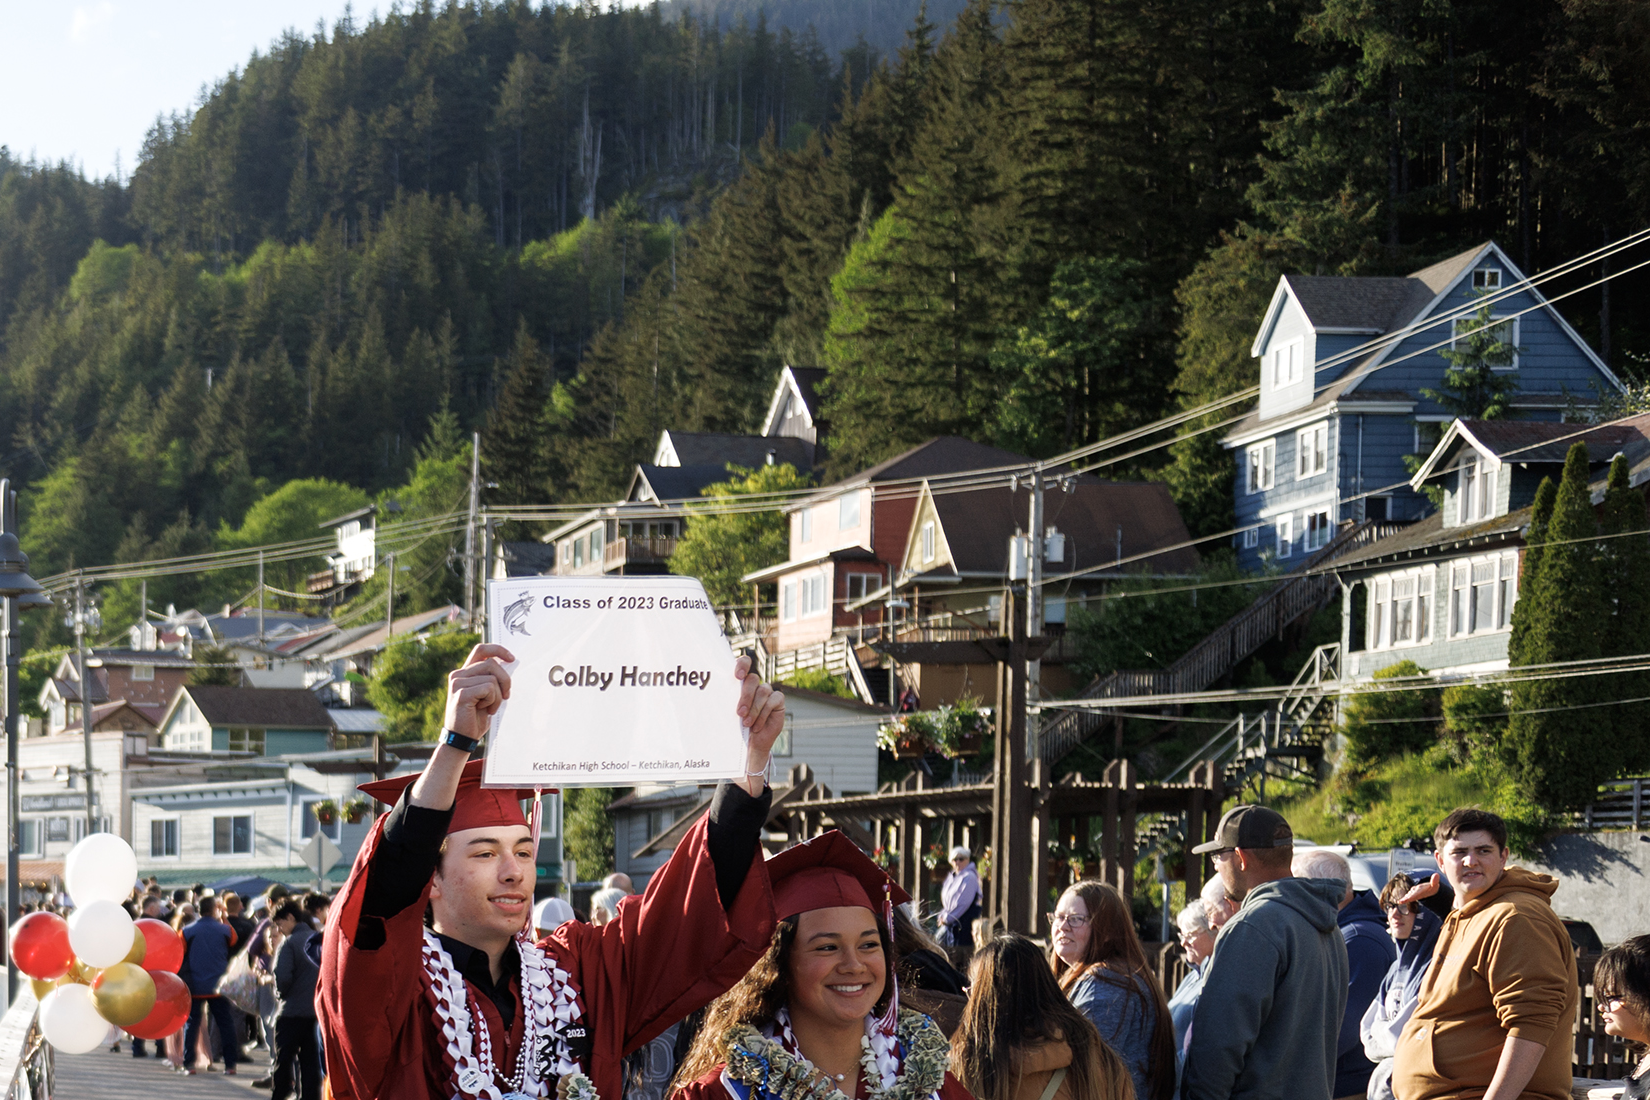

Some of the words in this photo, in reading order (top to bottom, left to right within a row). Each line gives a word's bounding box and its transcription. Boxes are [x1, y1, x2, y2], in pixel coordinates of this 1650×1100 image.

[543, 596, 591, 609] Class
[597, 597, 614, 610] of
[618, 597, 655, 610] 2023
[659, 596, 709, 611] Graduate
[549, 665, 614, 692] Colby
[620, 665, 711, 691] Hanchey
[533, 762, 577, 772] Ketchikan
[579, 762, 599, 773] High
[601, 761, 630, 771] School
[639, 760, 682, 771] Ketchikan,
[684, 759, 711, 769] Alaska
[566, 1028, 586, 1038] 2023
